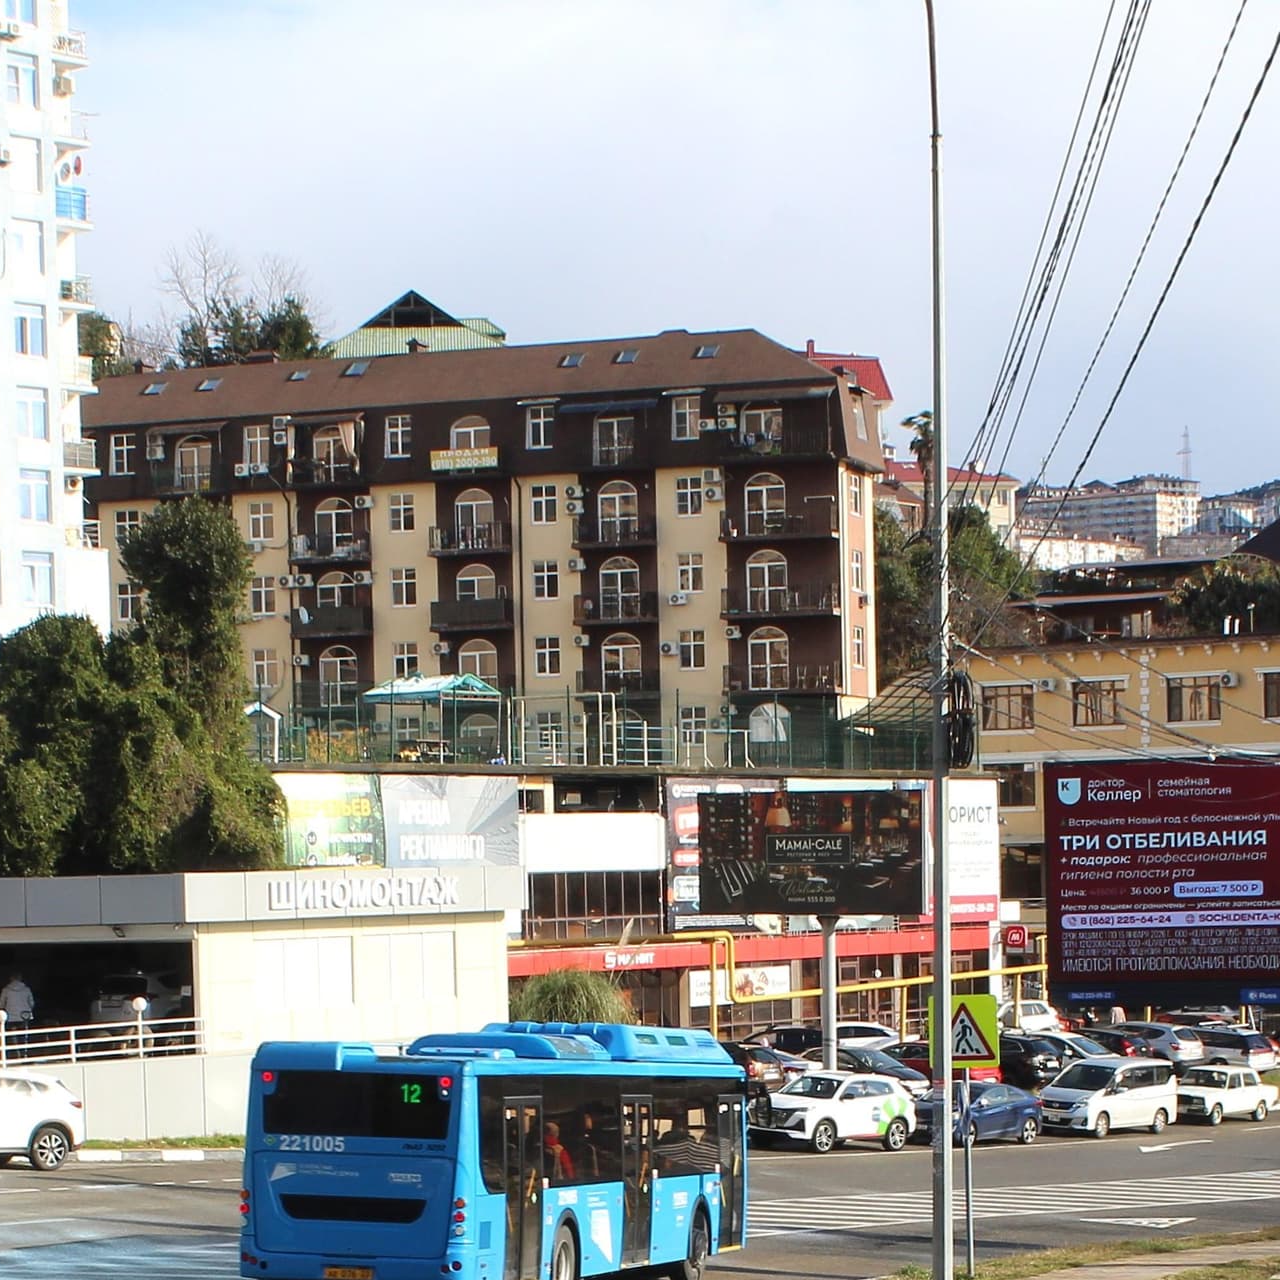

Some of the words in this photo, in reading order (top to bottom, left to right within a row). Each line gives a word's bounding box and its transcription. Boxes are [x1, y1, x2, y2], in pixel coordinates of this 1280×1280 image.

[1088, 779, 1125, 788] доктор
[1157, 777, 1210, 787] семейная
[1088, 789, 1141, 802] Келлер
[1157, 787, 1232, 797] стоматология
[1069, 816, 1125, 828] Встречайте
[1128, 815, 1162, 825] Новый
[1164, 816, 1181, 826] год
[1191, 813, 1261, 823] белоснежной
[400, 834, 485, 860] РЕКЛАМНОГО
[1060, 835, 1100, 851] ТРИ
[1106, 830, 1267, 850] ОТБЕЛИВАНИЯ
[1071, 855, 1131, 867] подарок:
[1138, 851, 1267, 865] профессиональная
[1060, 870, 1113, 881] гигиена
[1116, 869, 1169, 879] полости
[1172, 868, 1195, 878] рта
[269, 877, 459, 911] ШИНОМОНТАЖ
[1061, 889, 1087, 897] Цена:
[1130, 887, 1142, 896] 36
[1143, 886, 1162, 895] 000
[1179, 885, 1219, 895] Выгода:
[1221, 885, 1227, 893] 7
[1230, 884, 1249, 893] 500
[1061, 904, 1087, 912] Места
[1196, 901, 1231, 910] успейте
[1080, 917, 1088, 925] 8
[1089, 915, 1115, 926] (862)
[1116, 914, 1171, 924] 225-64-24
[1063, 958, 1112, 972] ИМЕЮТСЯ
[1116, 955, 1227, 971] ПРОТИВОПОКАЗАНИЯ.
[401, 1083, 421, 1103] 12
[279, 1135, 345, 1152] 221005
